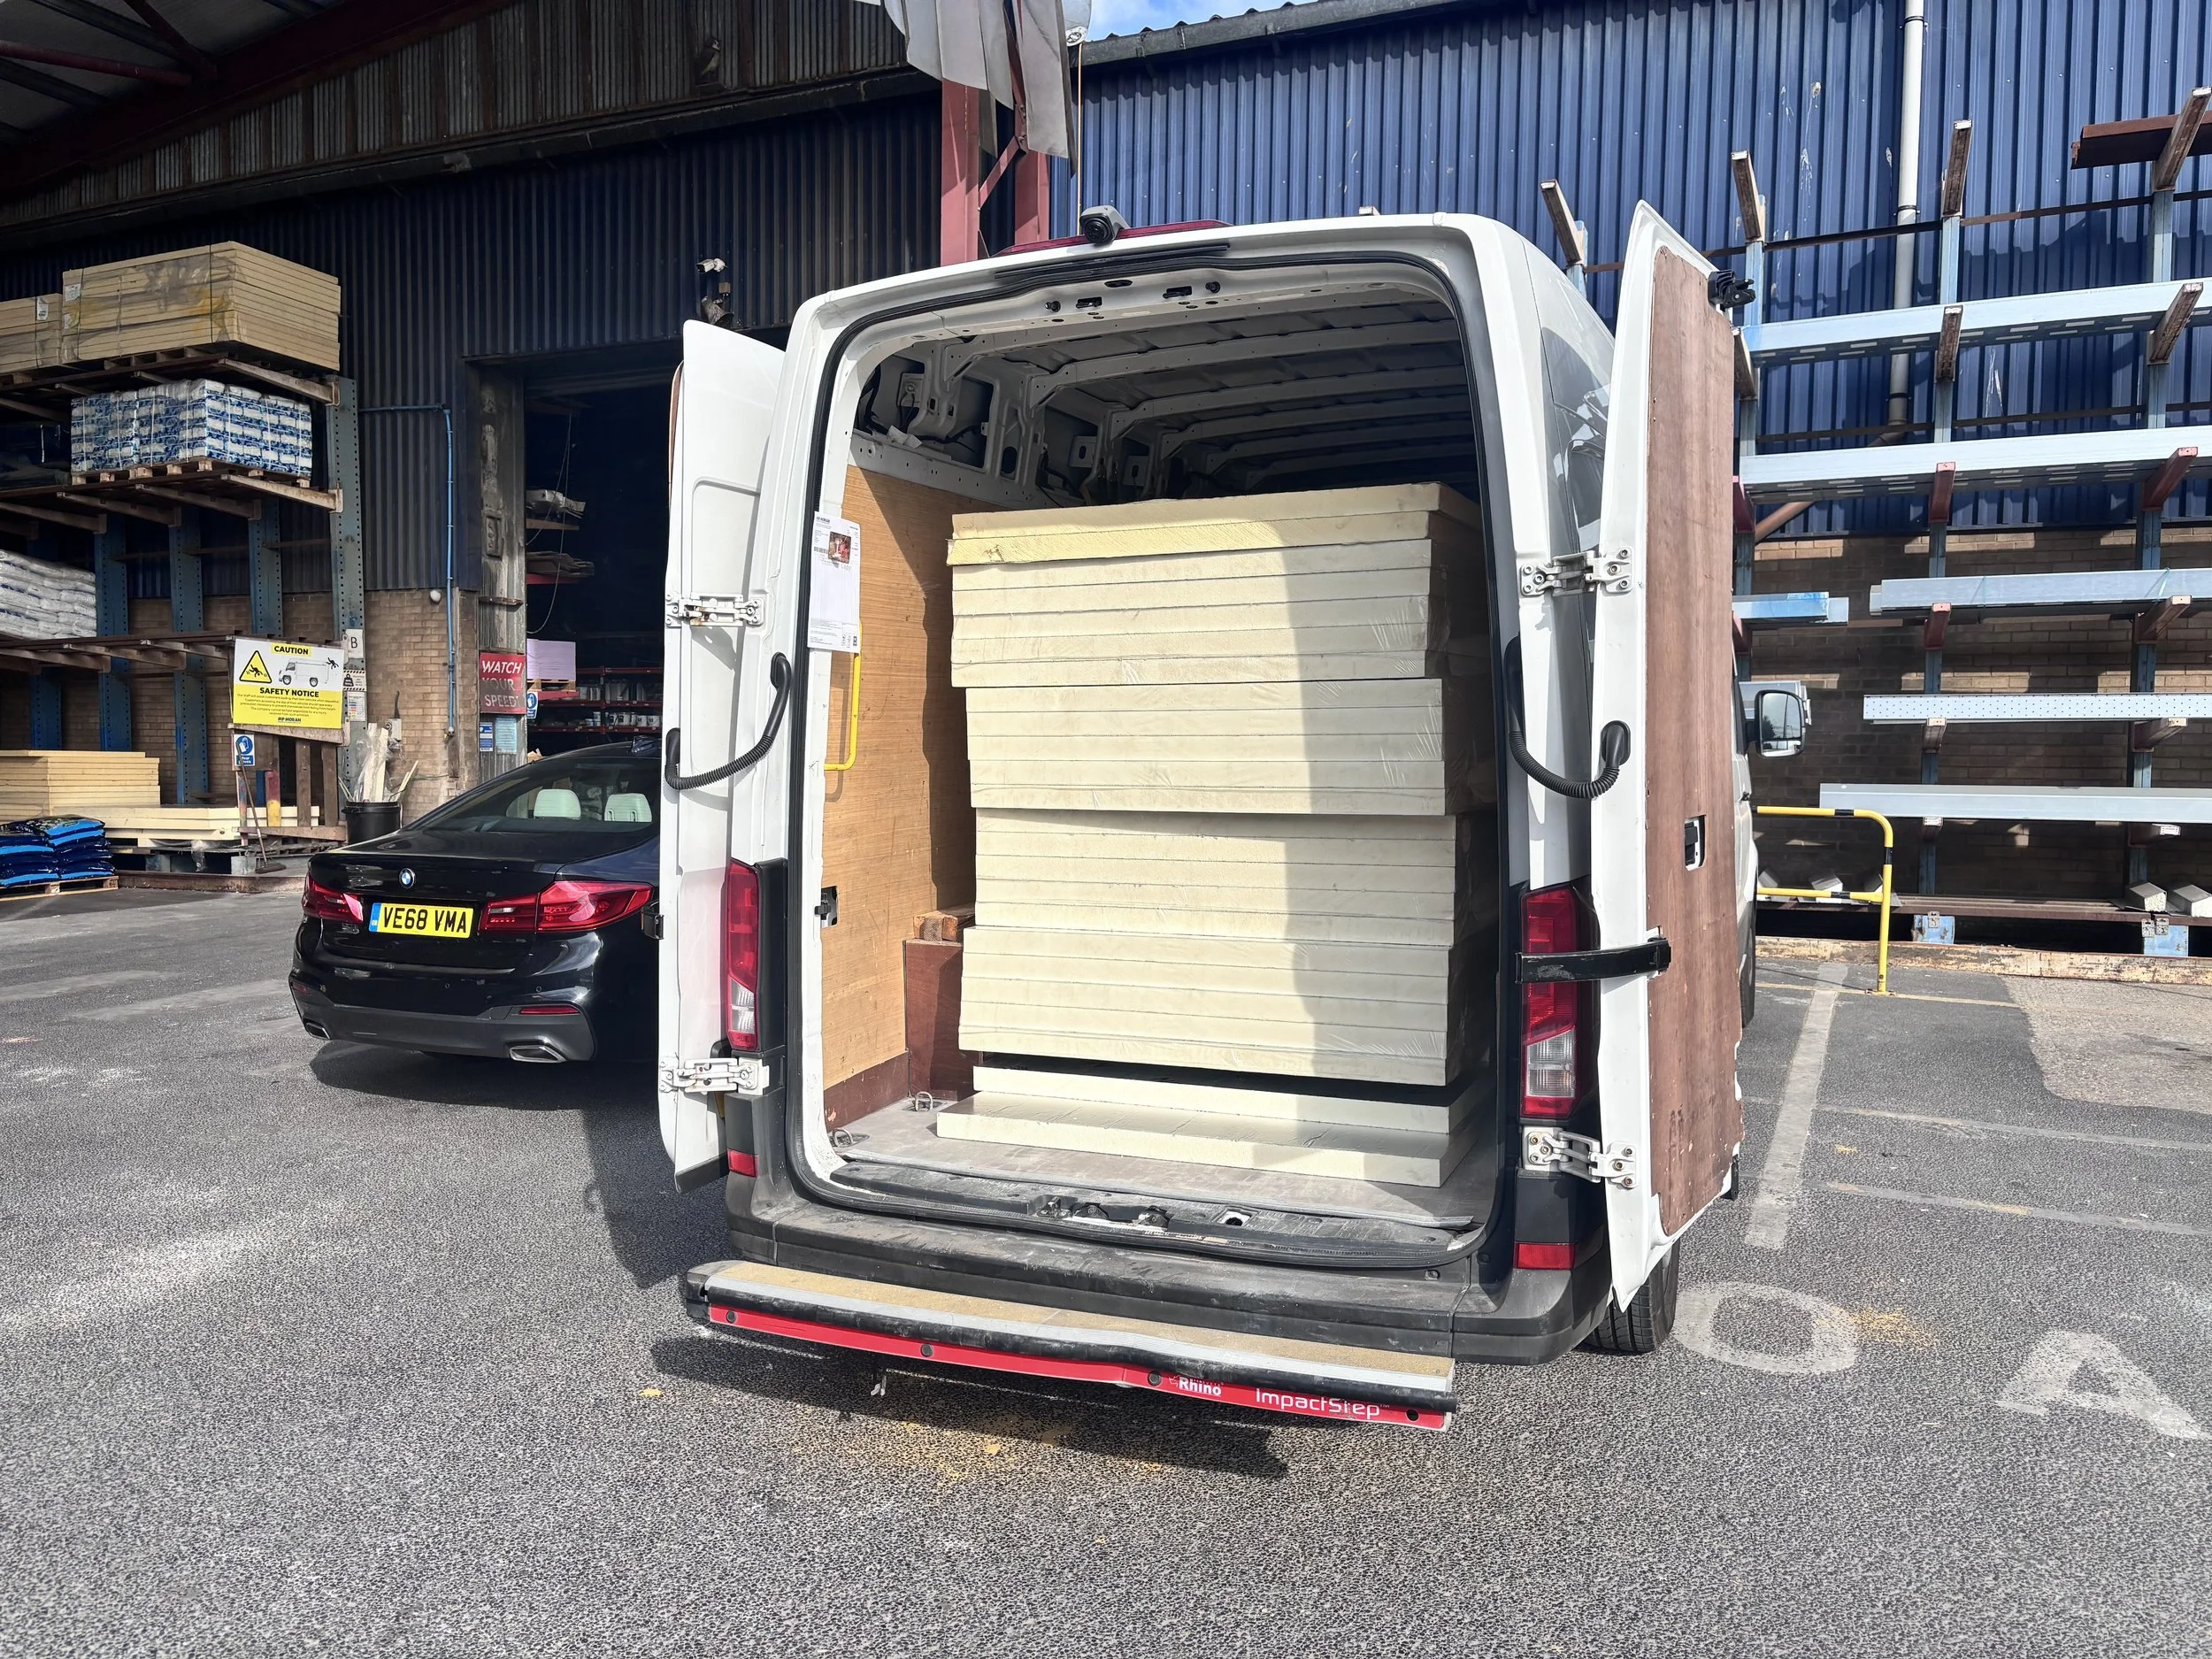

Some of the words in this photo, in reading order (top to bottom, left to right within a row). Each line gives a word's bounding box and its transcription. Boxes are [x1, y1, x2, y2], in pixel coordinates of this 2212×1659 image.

[350, 636, 358, 649] B
[274, 645, 309, 655] CAUTION
[481, 660, 523, 674] WATCH
[259, 687, 290, 696] SAFETY
[384, 906, 428, 930] VE68
[434, 910, 467, 933] VMA
[1179, 1376, 1222, 1396] Rhino
[1256, 1387, 1380, 1420] ImpactStep
